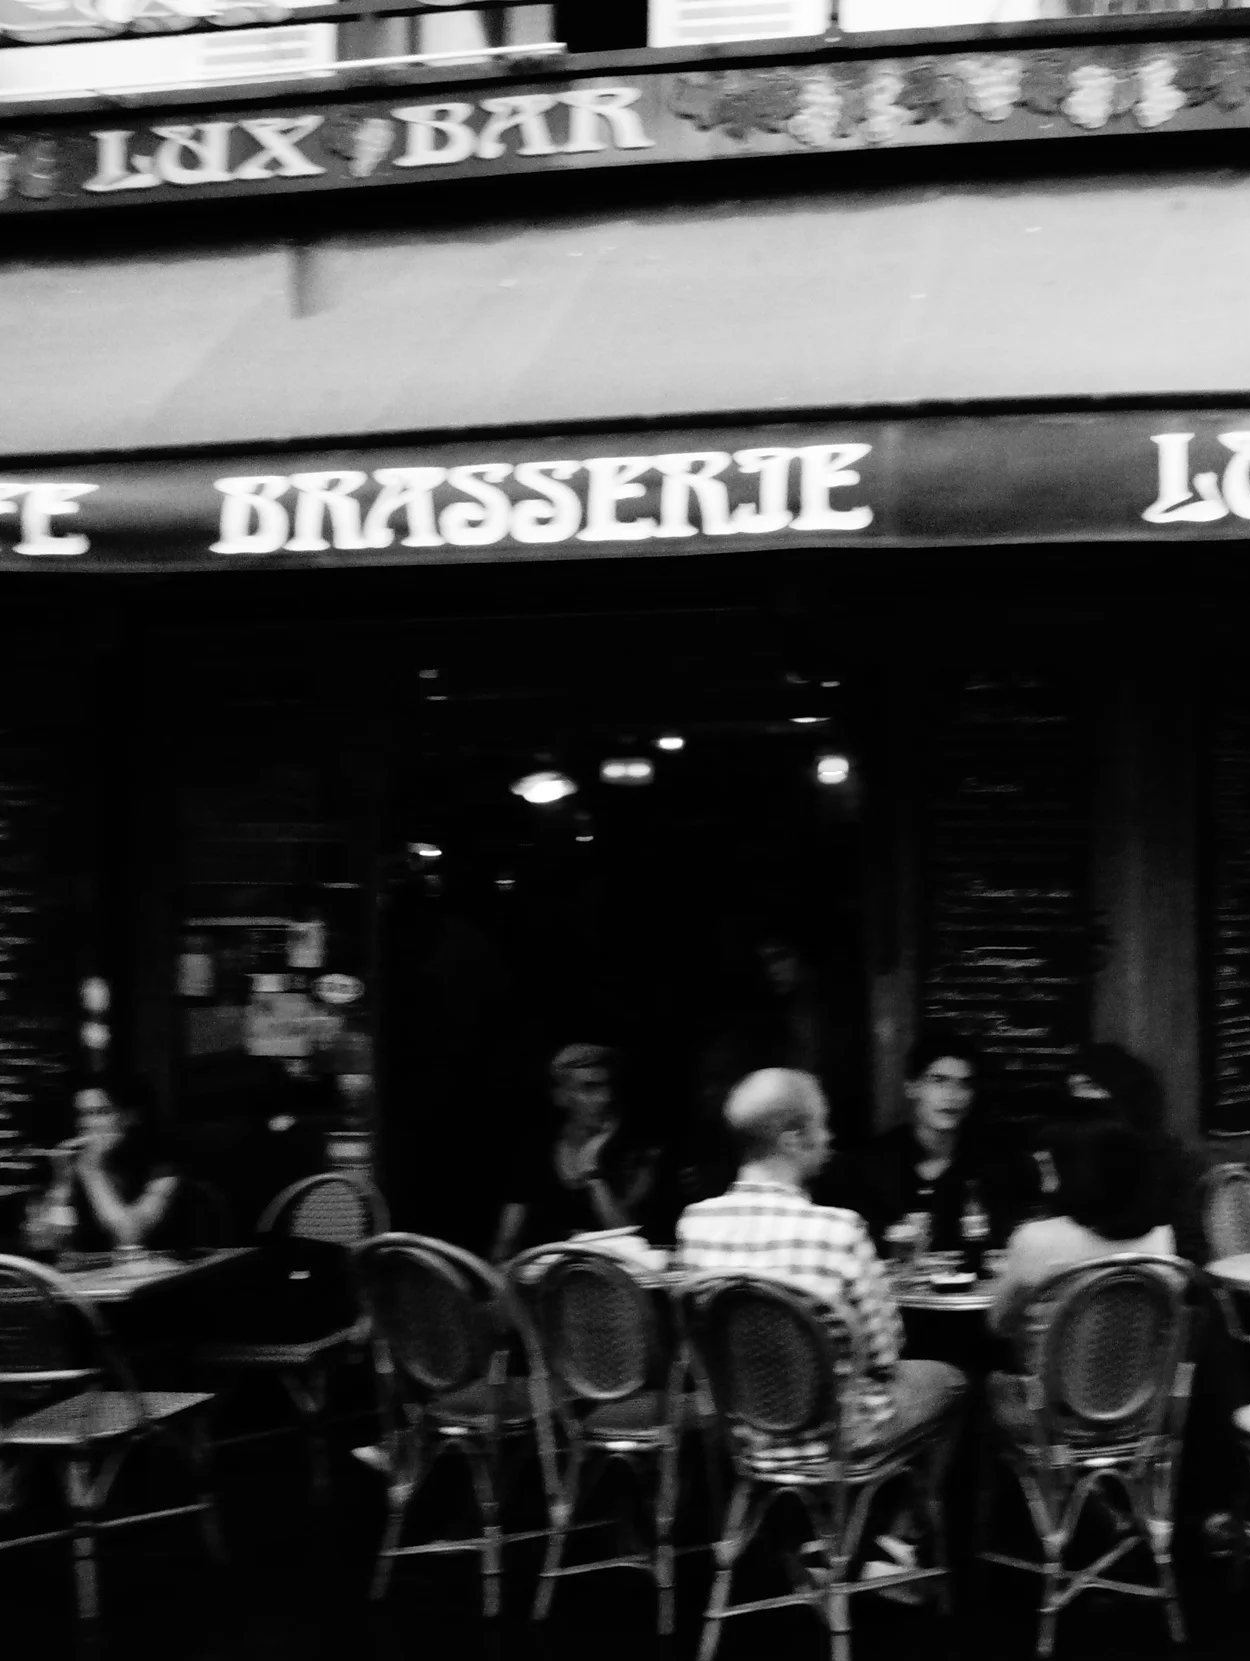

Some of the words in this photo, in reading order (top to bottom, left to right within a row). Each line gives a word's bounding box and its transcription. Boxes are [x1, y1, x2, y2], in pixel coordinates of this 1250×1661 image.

[82, 114, 327, 192] LUX
[391, 87, 656, 167] BAR
[209, 442, 874, 554] BRASSERIE
